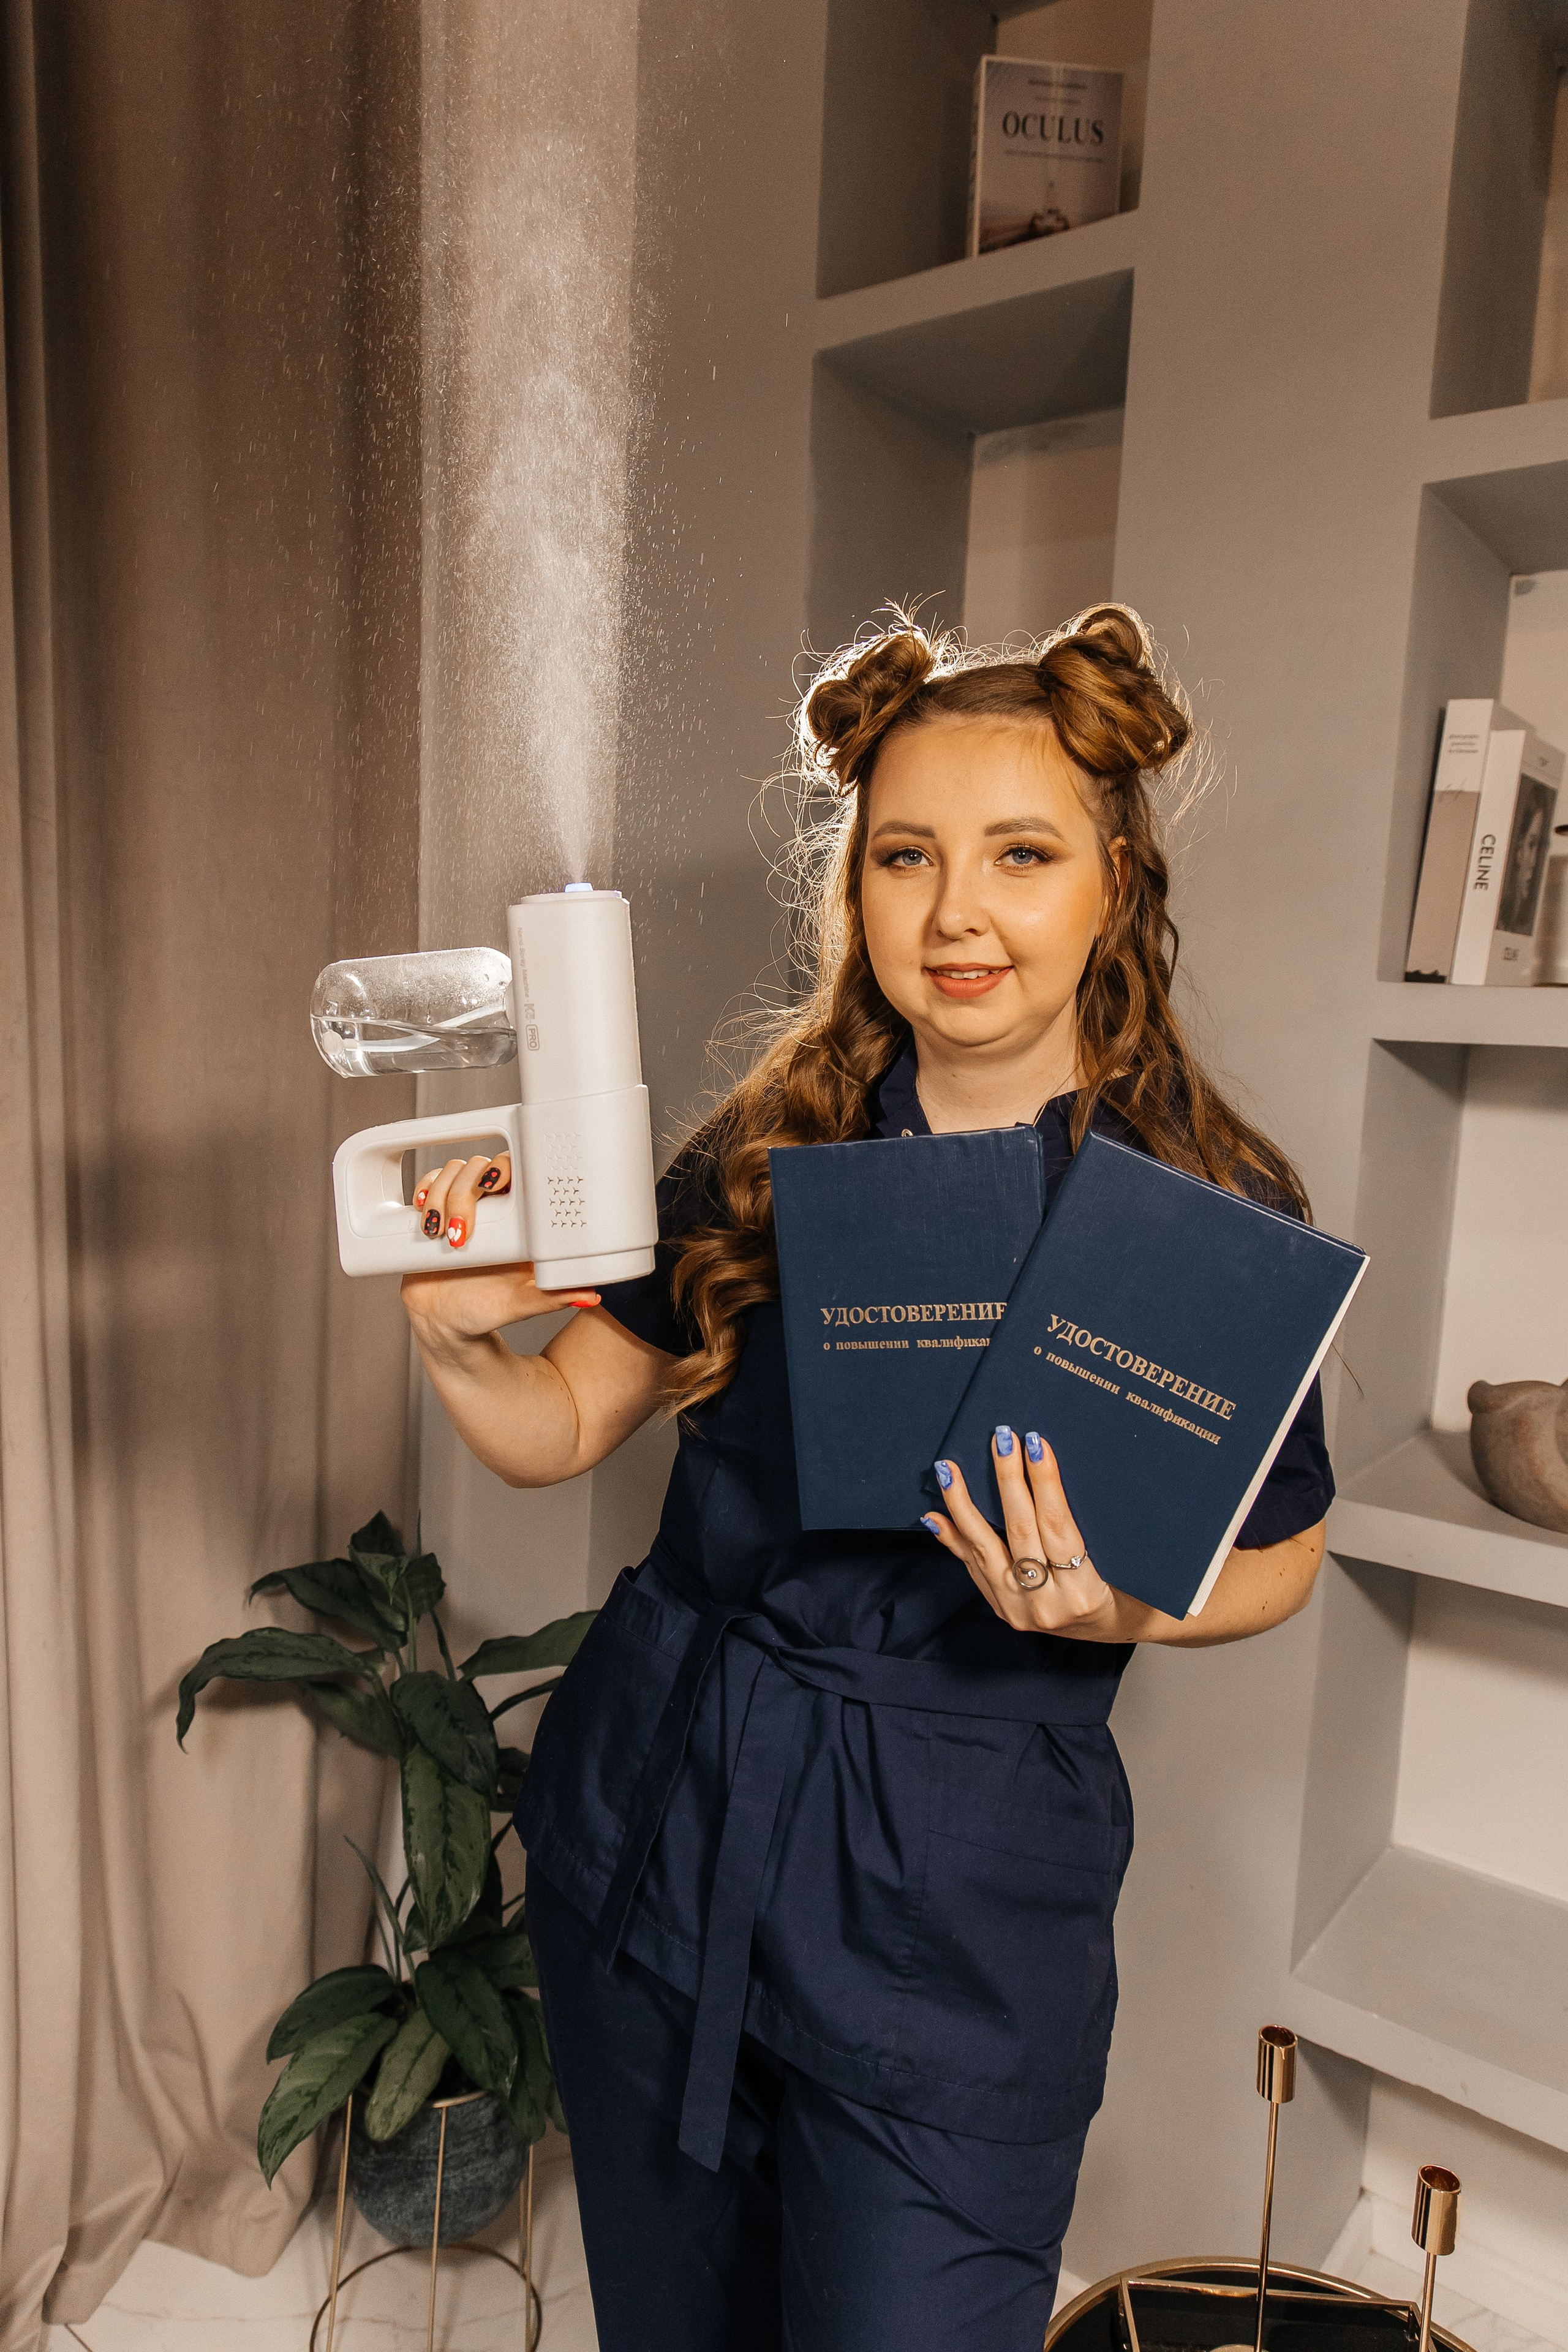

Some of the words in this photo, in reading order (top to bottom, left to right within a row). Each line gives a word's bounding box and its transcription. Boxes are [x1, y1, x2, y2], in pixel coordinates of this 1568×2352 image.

[1002, 111, 1104, 146] OCULUS
[1473, 834, 1496, 890] CELINE
[529, 1028, 537, 1048] PRO
[823, 1342, 831, 1351] о
[835, 1340, 910, 1350] повышении
[1047, 1314, 1237, 1420] УДОСТОВЕРЕНИЕ
[1033, 1346, 1042, 1355] о
[1045, 1351, 1121, 1395] повышении
[1125, 1391, 1221, 1445] квалификации
